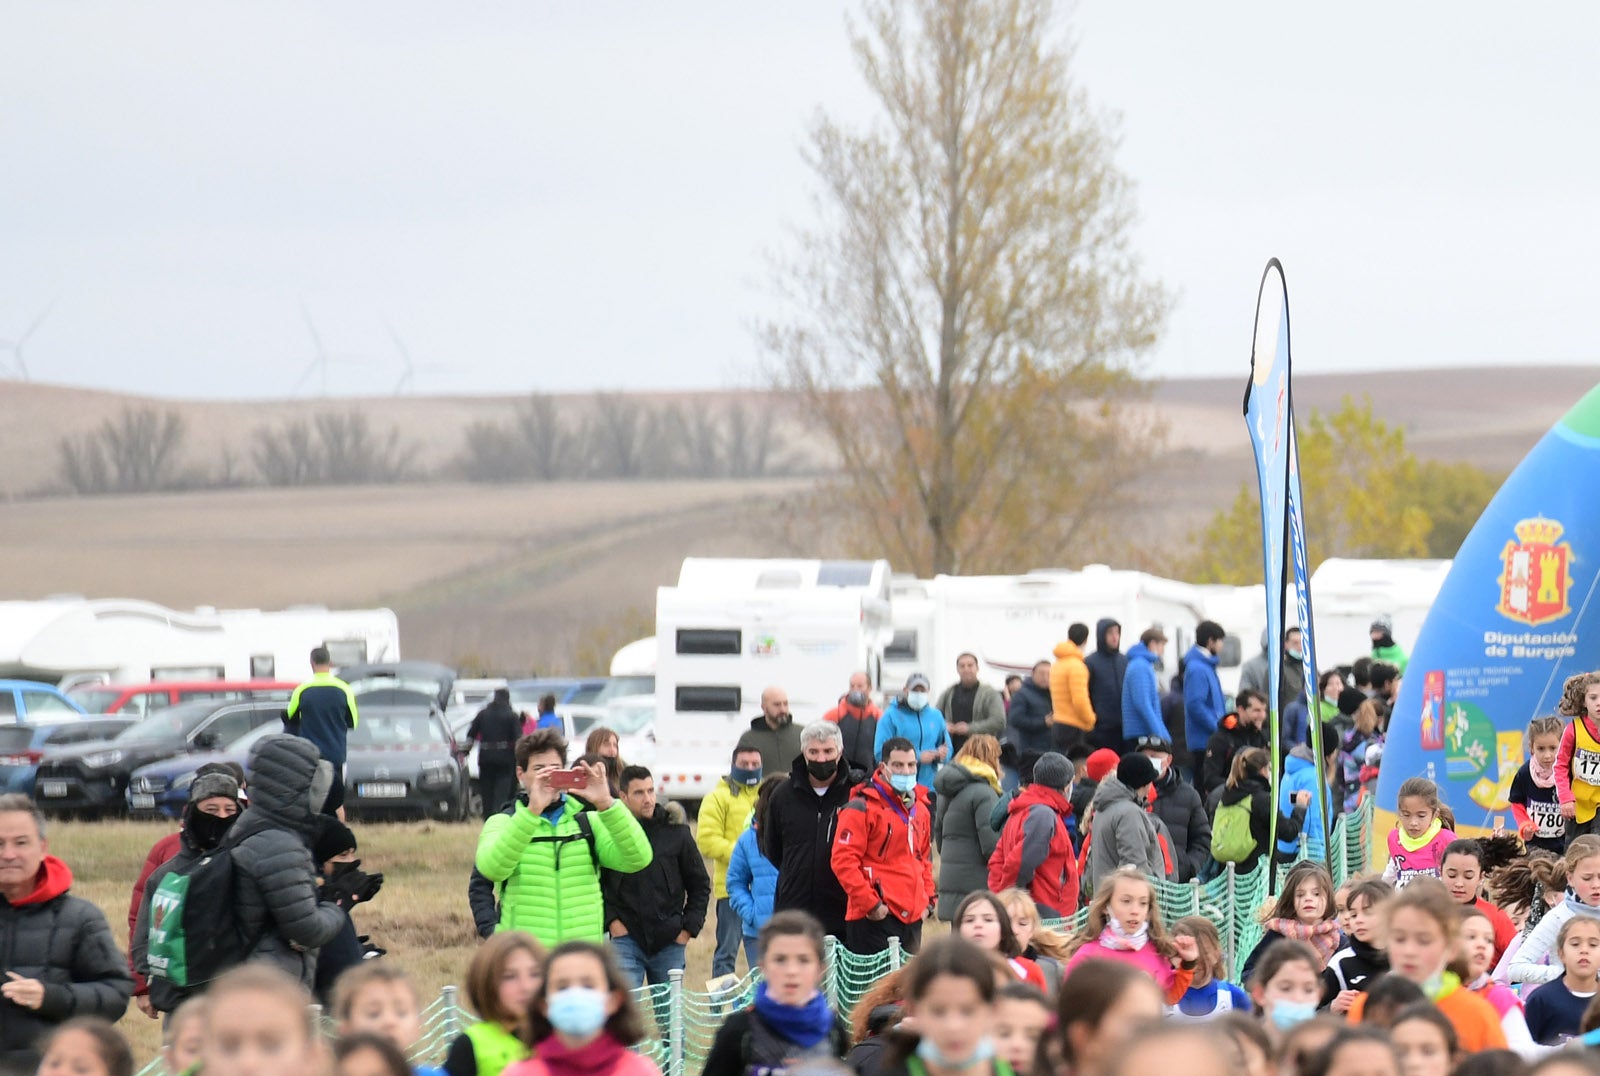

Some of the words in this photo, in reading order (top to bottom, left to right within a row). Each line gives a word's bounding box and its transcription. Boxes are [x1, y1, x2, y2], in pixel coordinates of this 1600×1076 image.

[1483, 631, 1578, 648] Diputación
[1485, 646, 1508, 658] de
[1511, 646, 1576, 660] Burgos
[1530, 812, 1564, 829] 1780
